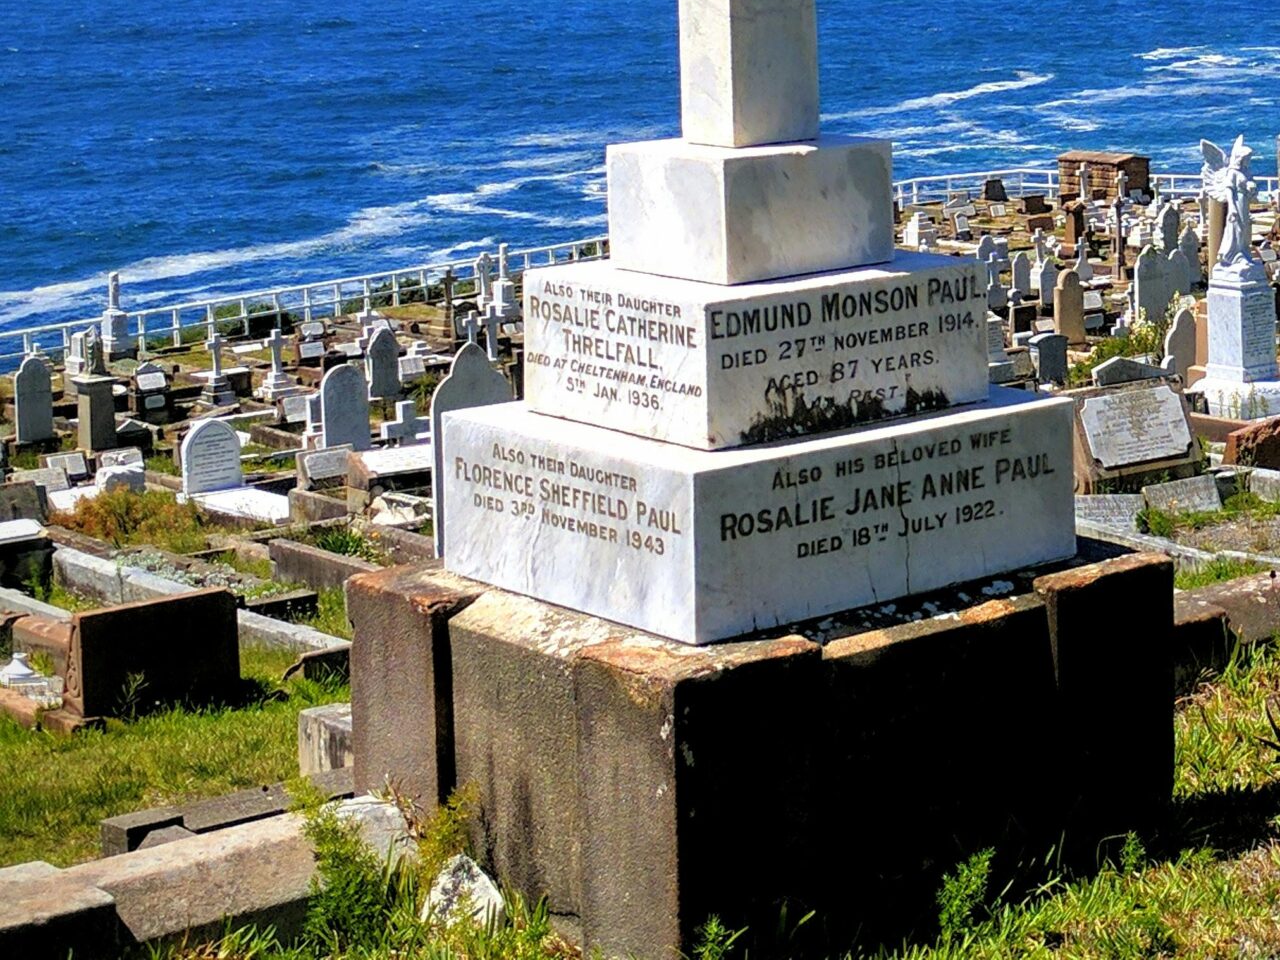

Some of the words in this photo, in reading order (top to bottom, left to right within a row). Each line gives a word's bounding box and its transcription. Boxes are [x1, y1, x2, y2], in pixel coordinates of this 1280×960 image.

[530, 296, 600, 330] ROSALIE
[605, 310, 697, 348] CATHERINE
[580, 289, 612, 306] THEIR
[618, 294, 681, 318] DAUGHTER
[711, 302, 811, 339] EDMUND
[822, 284, 918, 322] MONSON
[928, 275, 986, 306] PAUL.
[562, 328, 663, 371] THRELFALL.
[721, 349, 767, 370] DIED
[834, 322, 929, 350] NOVEMBER
[939, 311, 979, 333] 1914.
[829, 360, 858, 383] 87
[871, 350, 939, 373] YEARS.
[527, 352, 550, 366] DIED
[553, 358, 567, 370] AT
[650, 375, 702, 397] ENGLAND
[594, 383, 622, 402] JAN.
[629, 390, 663, 411] 1936.
[493, 443, 525, 465] ALSO
[530, 454, 565, 474] THEIR
[570, 462, 637, 492] DAUGHTER
[772, 466, 822, 490] ALSO
[836, 458, 864, 477] HIS
[875, 439, 962, 469] BELOVED
[970, 429, 1011, 450] WIFE
[455, 457, 533, 497] FLORENCE
[539, 478, 628, 521] SHEFFIELD
[637, 501, 682, 534] PAUL
[720, 496, 835, 541] ROSALIE
[846, 481, 912, 515] JANE
[921, 466, 985, 500] ANNE
[995, 453, 1055, 484] PAUL
[473, 493, 504, 512] DIED
[542, 508, 618, 544] NOVEMBER
[626, 529, 664, 556] 1943
[797, 536, 842, 558] DIED
[898, 512, 947, 537] JULY
[956, 500, 1004, 524] 1922.
